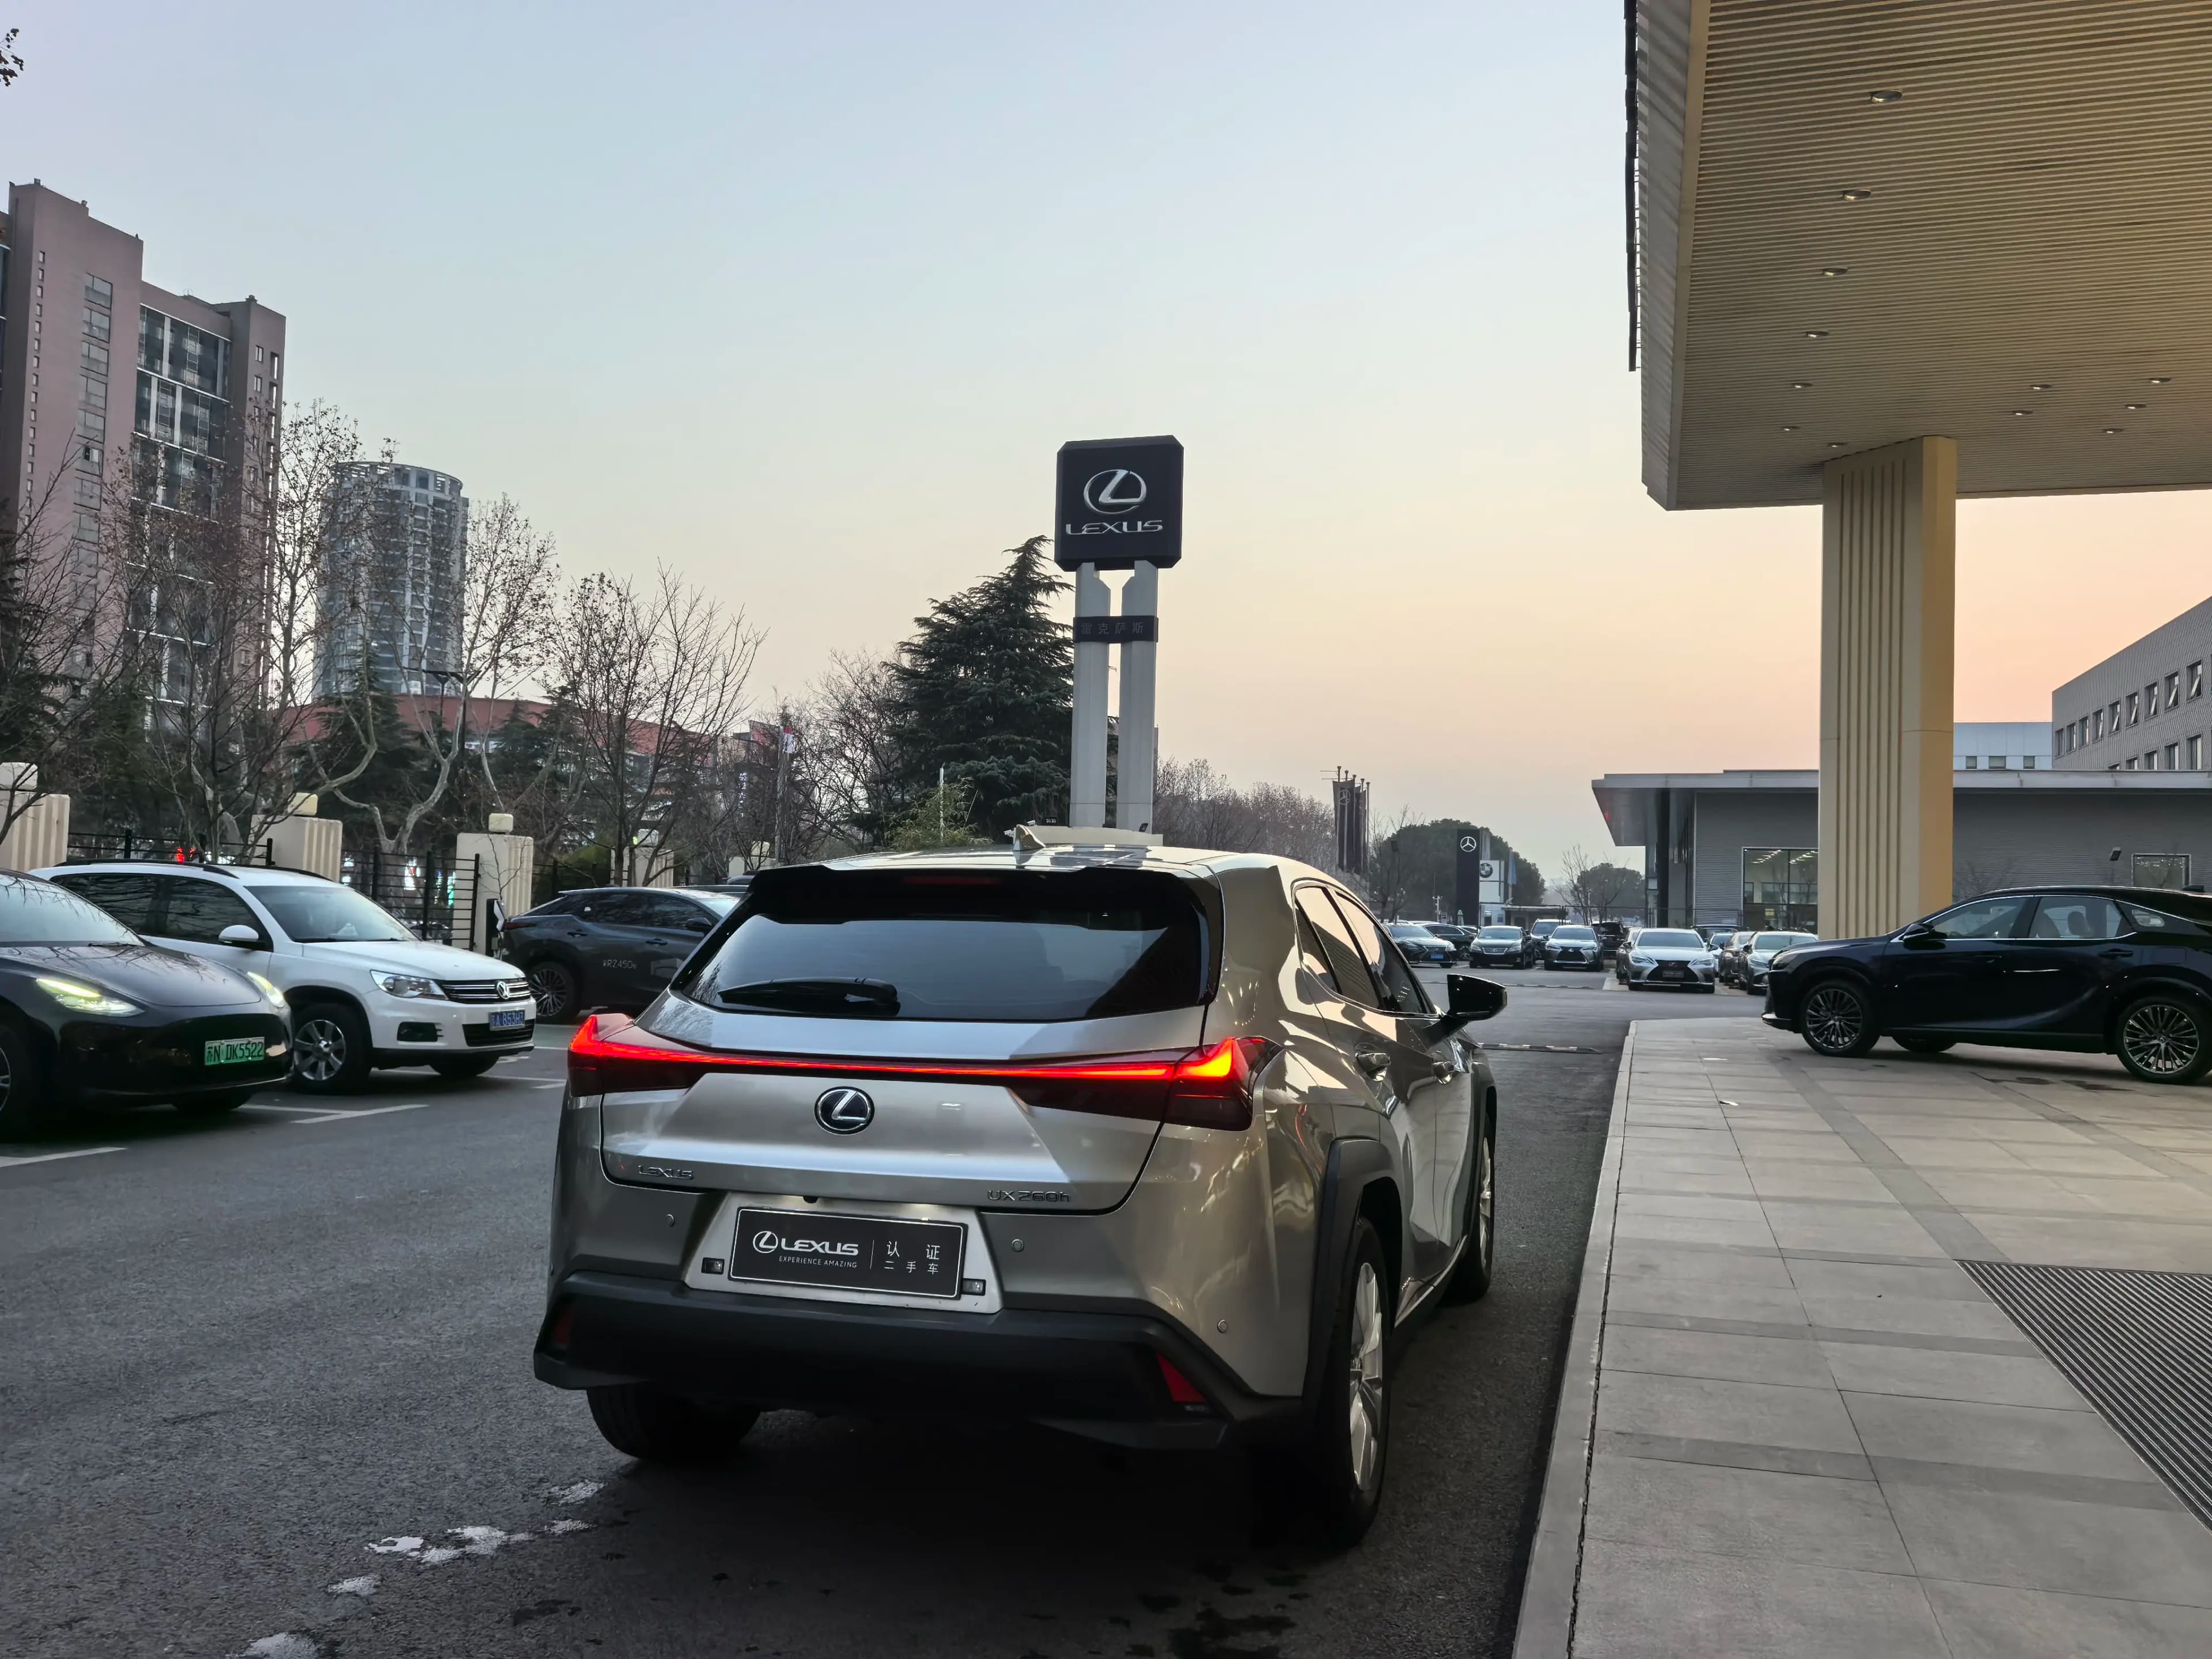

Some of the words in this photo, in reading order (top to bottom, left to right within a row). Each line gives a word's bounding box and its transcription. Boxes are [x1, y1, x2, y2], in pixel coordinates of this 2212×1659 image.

[1066, 520, 1163, 535] LEXUS
[1081, 622, 1144, 635] 雷克萨斯
[225, 1041, 263, 1060] DK5522
[638, 1165, 693, 1180] LEXUS
[987, 1190, 1015, 1201] UX
[781, 1238, 859, 1256] LEXUS
[779, 1256, 821, 1265] EXPERIENCE
[824, 1260, 857, 1268] AMAZING
